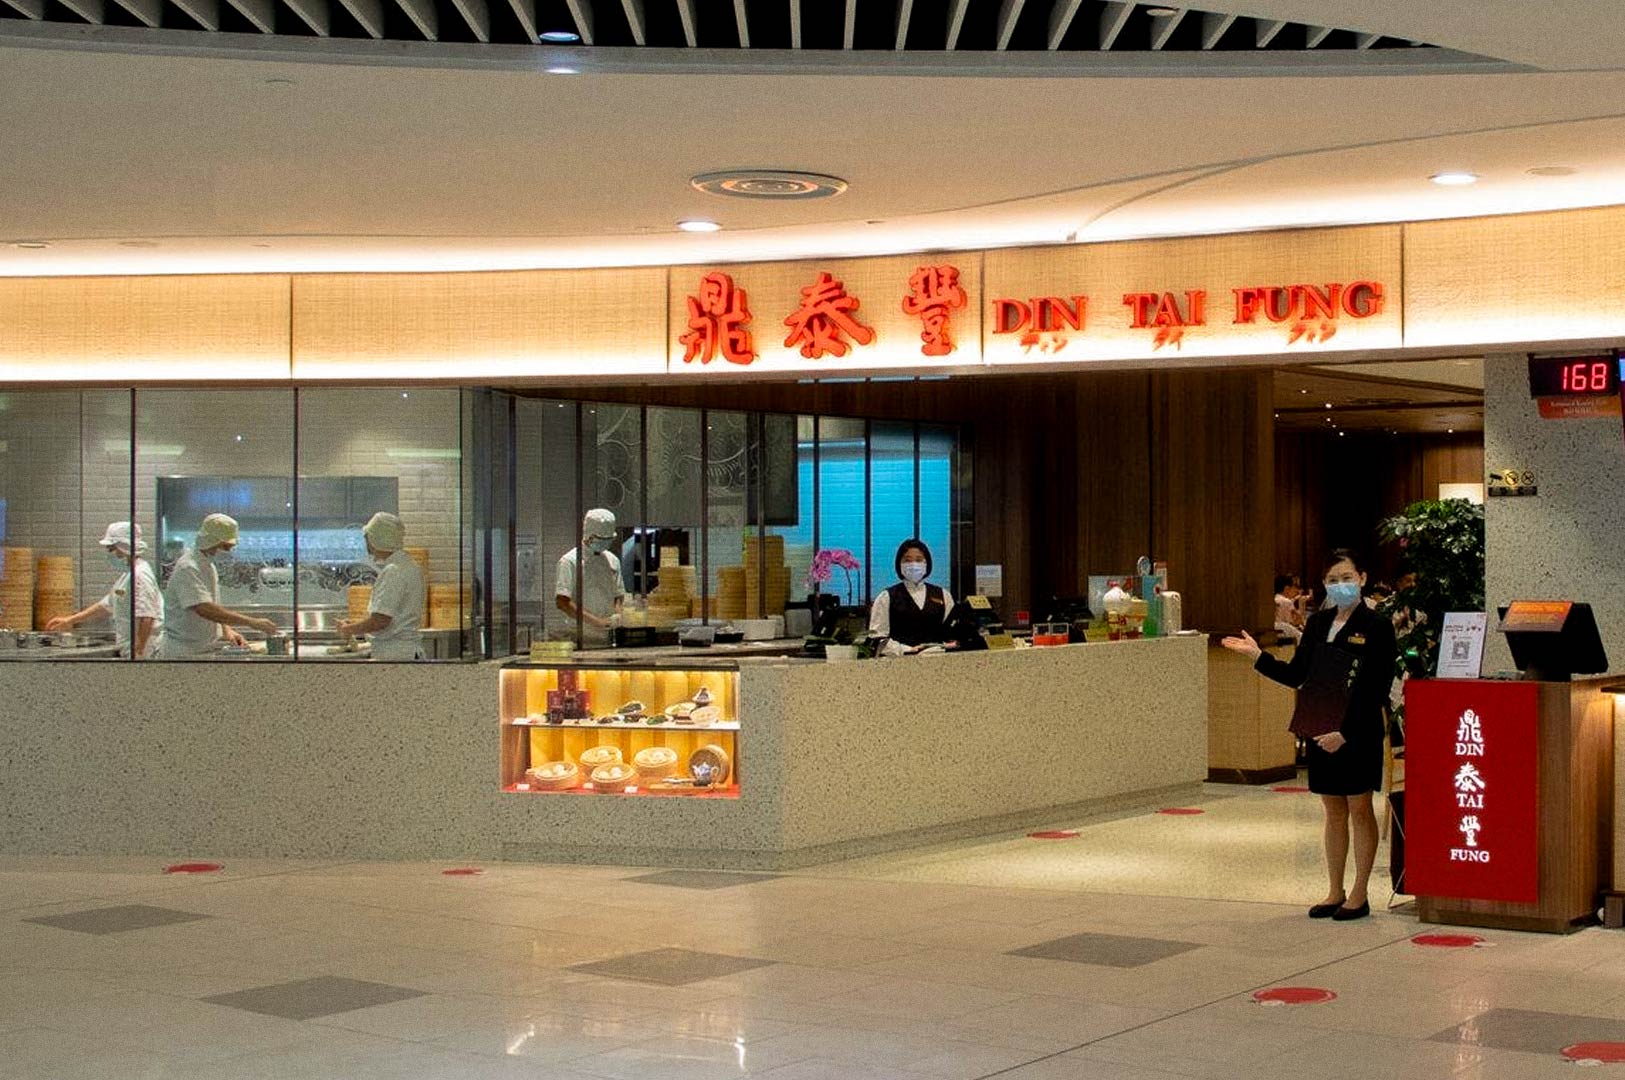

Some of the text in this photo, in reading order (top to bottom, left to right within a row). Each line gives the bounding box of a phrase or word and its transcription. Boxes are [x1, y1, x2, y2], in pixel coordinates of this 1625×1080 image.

[679, 264, 967, 365] 鼎泰豐
[992, 280, 1384, 334] DIN TAI FUNG
[1562, 363, 1607, 391] 168
[1456, 709, 1484, 743] 鼎
[1455, 743, 1485, 756] DIN
[1454, 761, 1486, 792] 泰
[1456, 794, 1484, 808] TAI
[1450, 849, 1490, 863] FUNG
